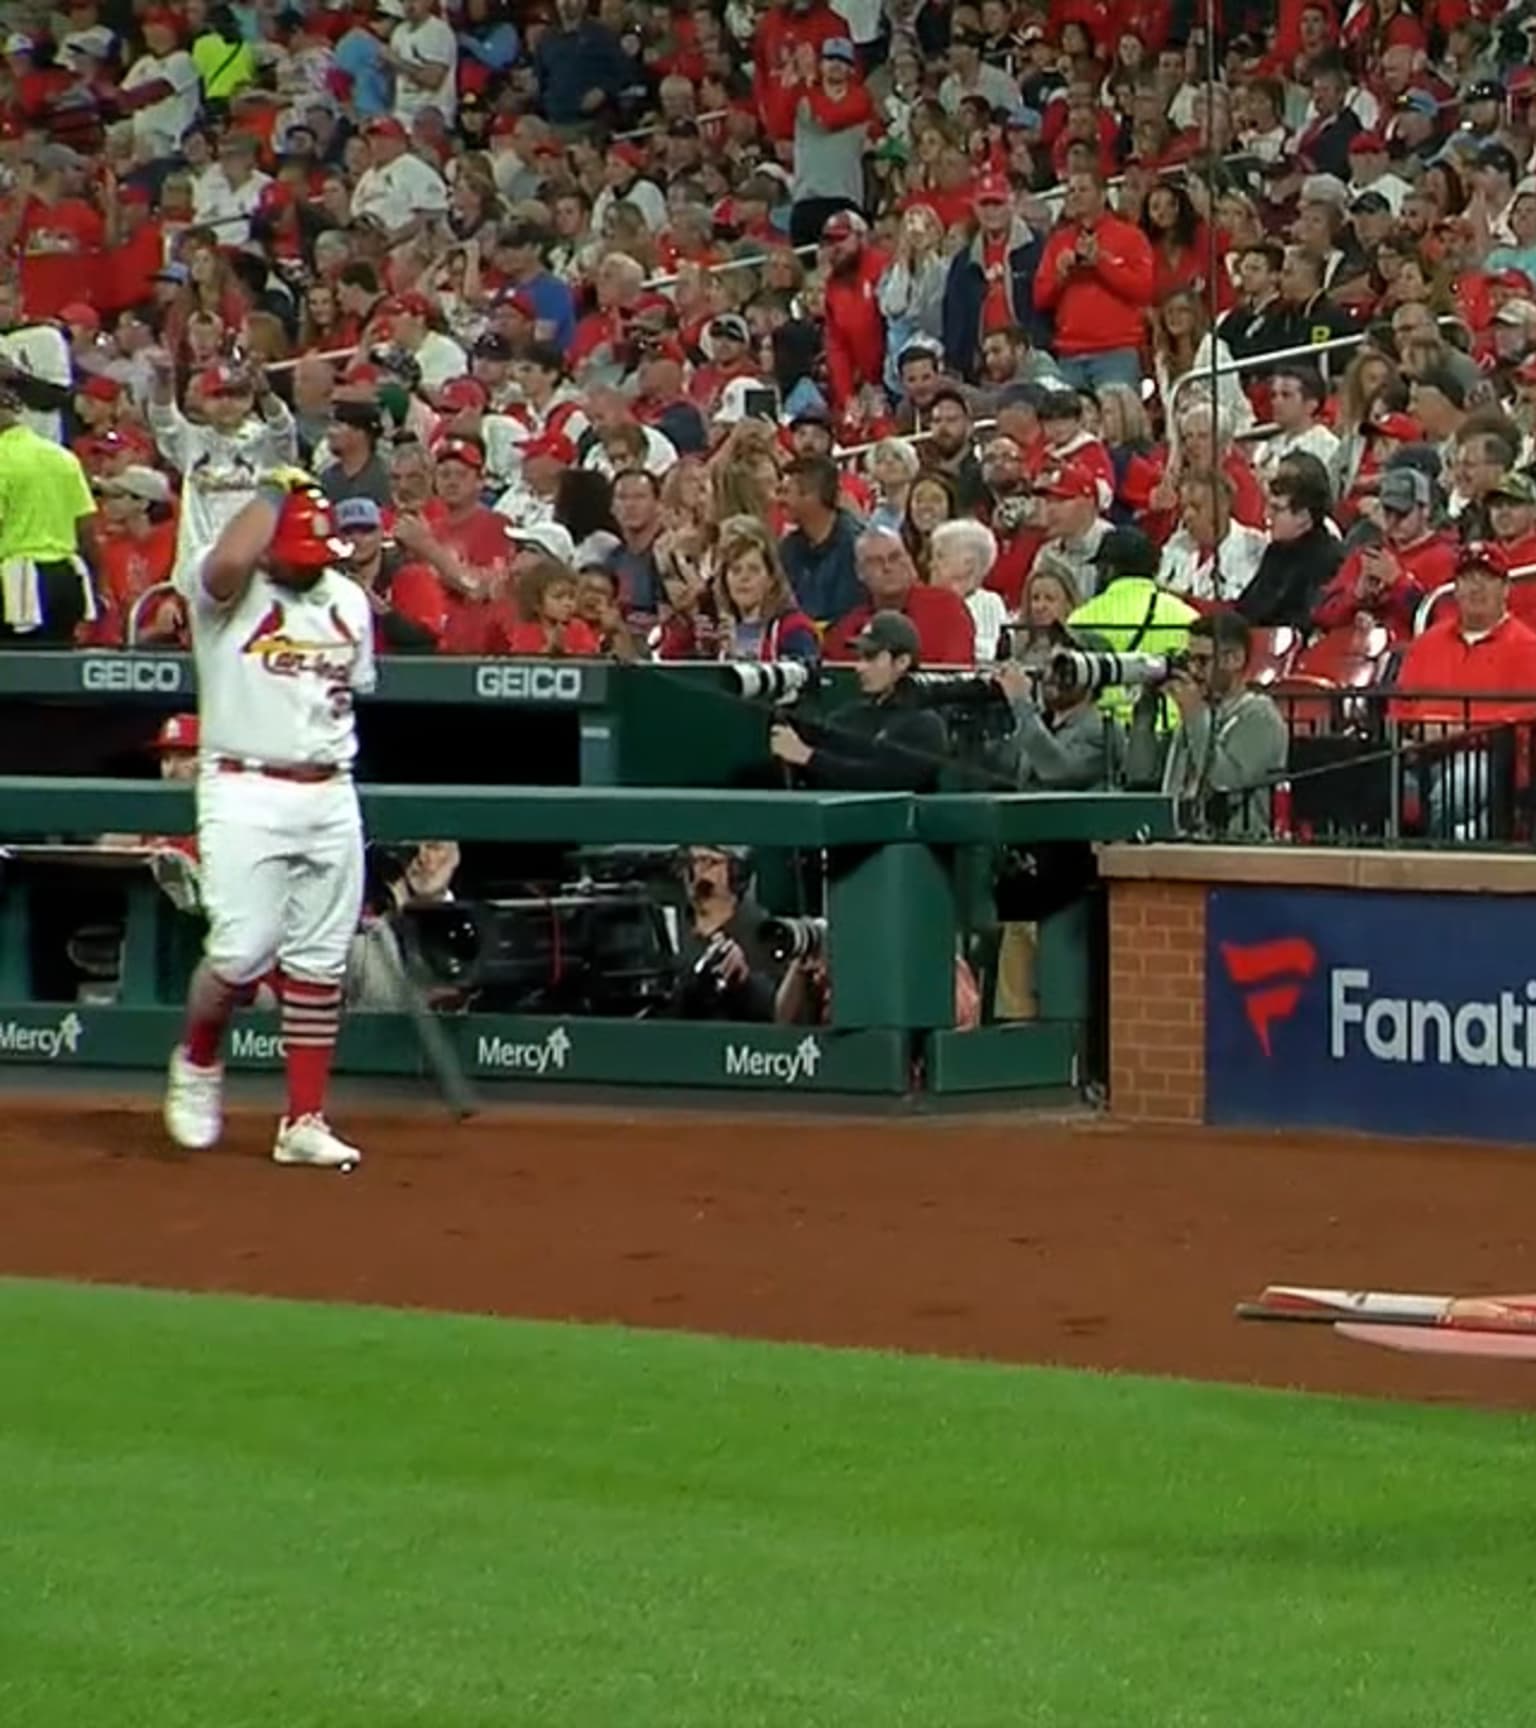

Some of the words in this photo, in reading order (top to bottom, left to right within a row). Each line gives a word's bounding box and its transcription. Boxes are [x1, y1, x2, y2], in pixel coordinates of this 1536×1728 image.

[82, 659, 181, 691] GEICO
[477, 665, 582, 699] GEICO
[0, 1022, 61, 1057] Mercy
[232, 1030, 288, 1057] Merc
[478, 1036, 550, 1074] Mercy
[725, 1045, 800, 1083] Mercy
